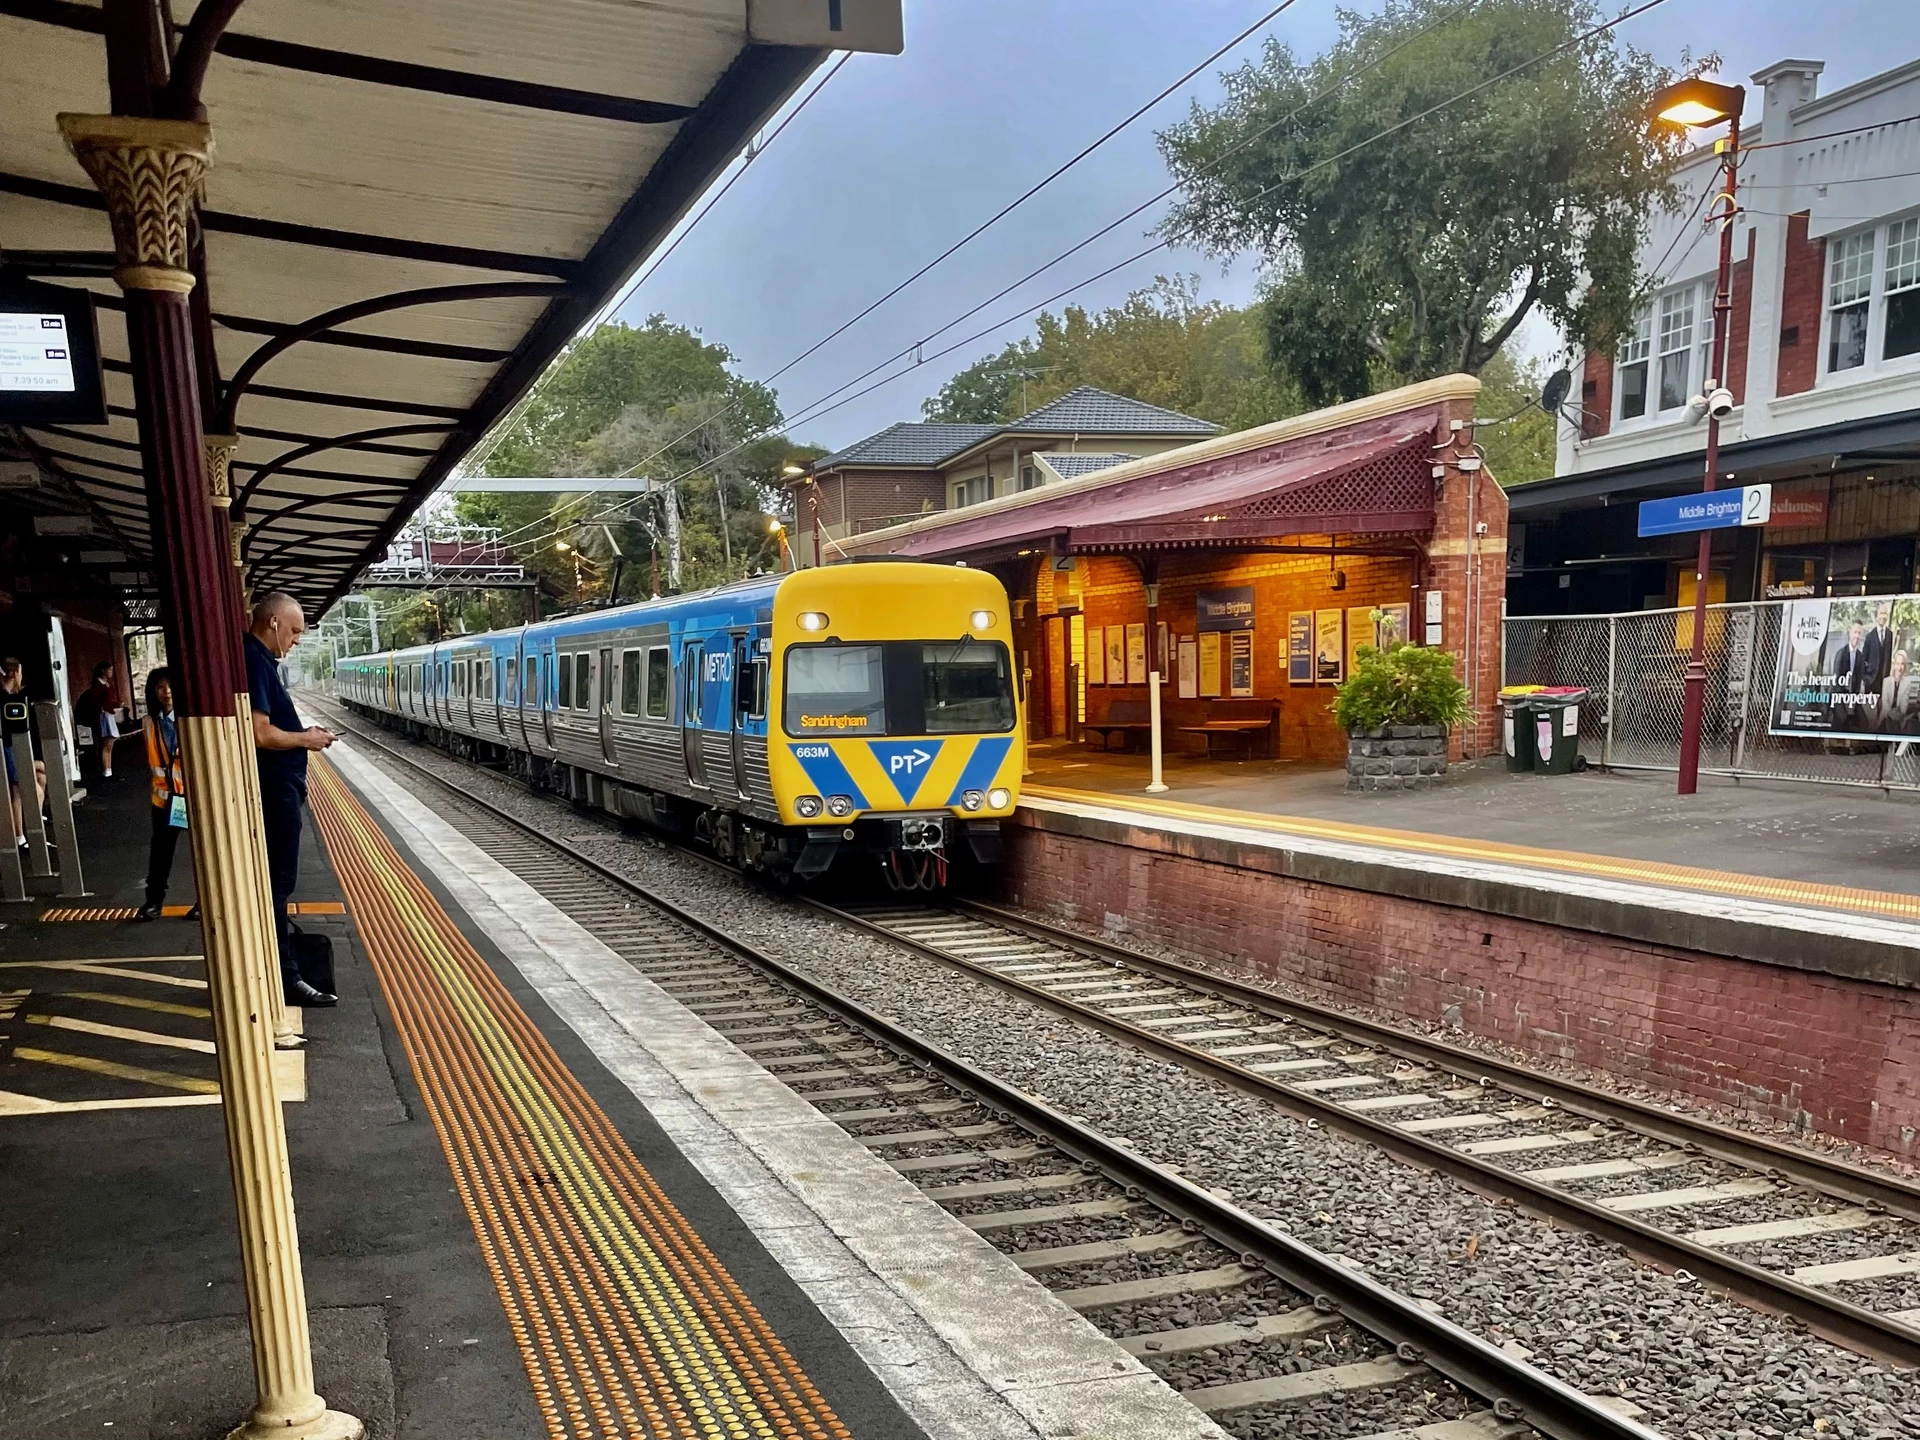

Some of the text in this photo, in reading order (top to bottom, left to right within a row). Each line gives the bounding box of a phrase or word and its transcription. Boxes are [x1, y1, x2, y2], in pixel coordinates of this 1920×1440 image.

[1678, 490, 1761, 520] Middle Brighton 2
[1226, 602, 1252, 616] Brighton
[1798, 616, 1820, 628] Jellis
[1796, 628, 1820, 640] Craig
[704, 652, 732, 682] METRO
[1786, 670, 1852, 686] The heart of
[1784, 688, 1880, 710] Brighton property
[800, 714, 868, 729] Sandringham
[796, 746, 829, 758] 663M
